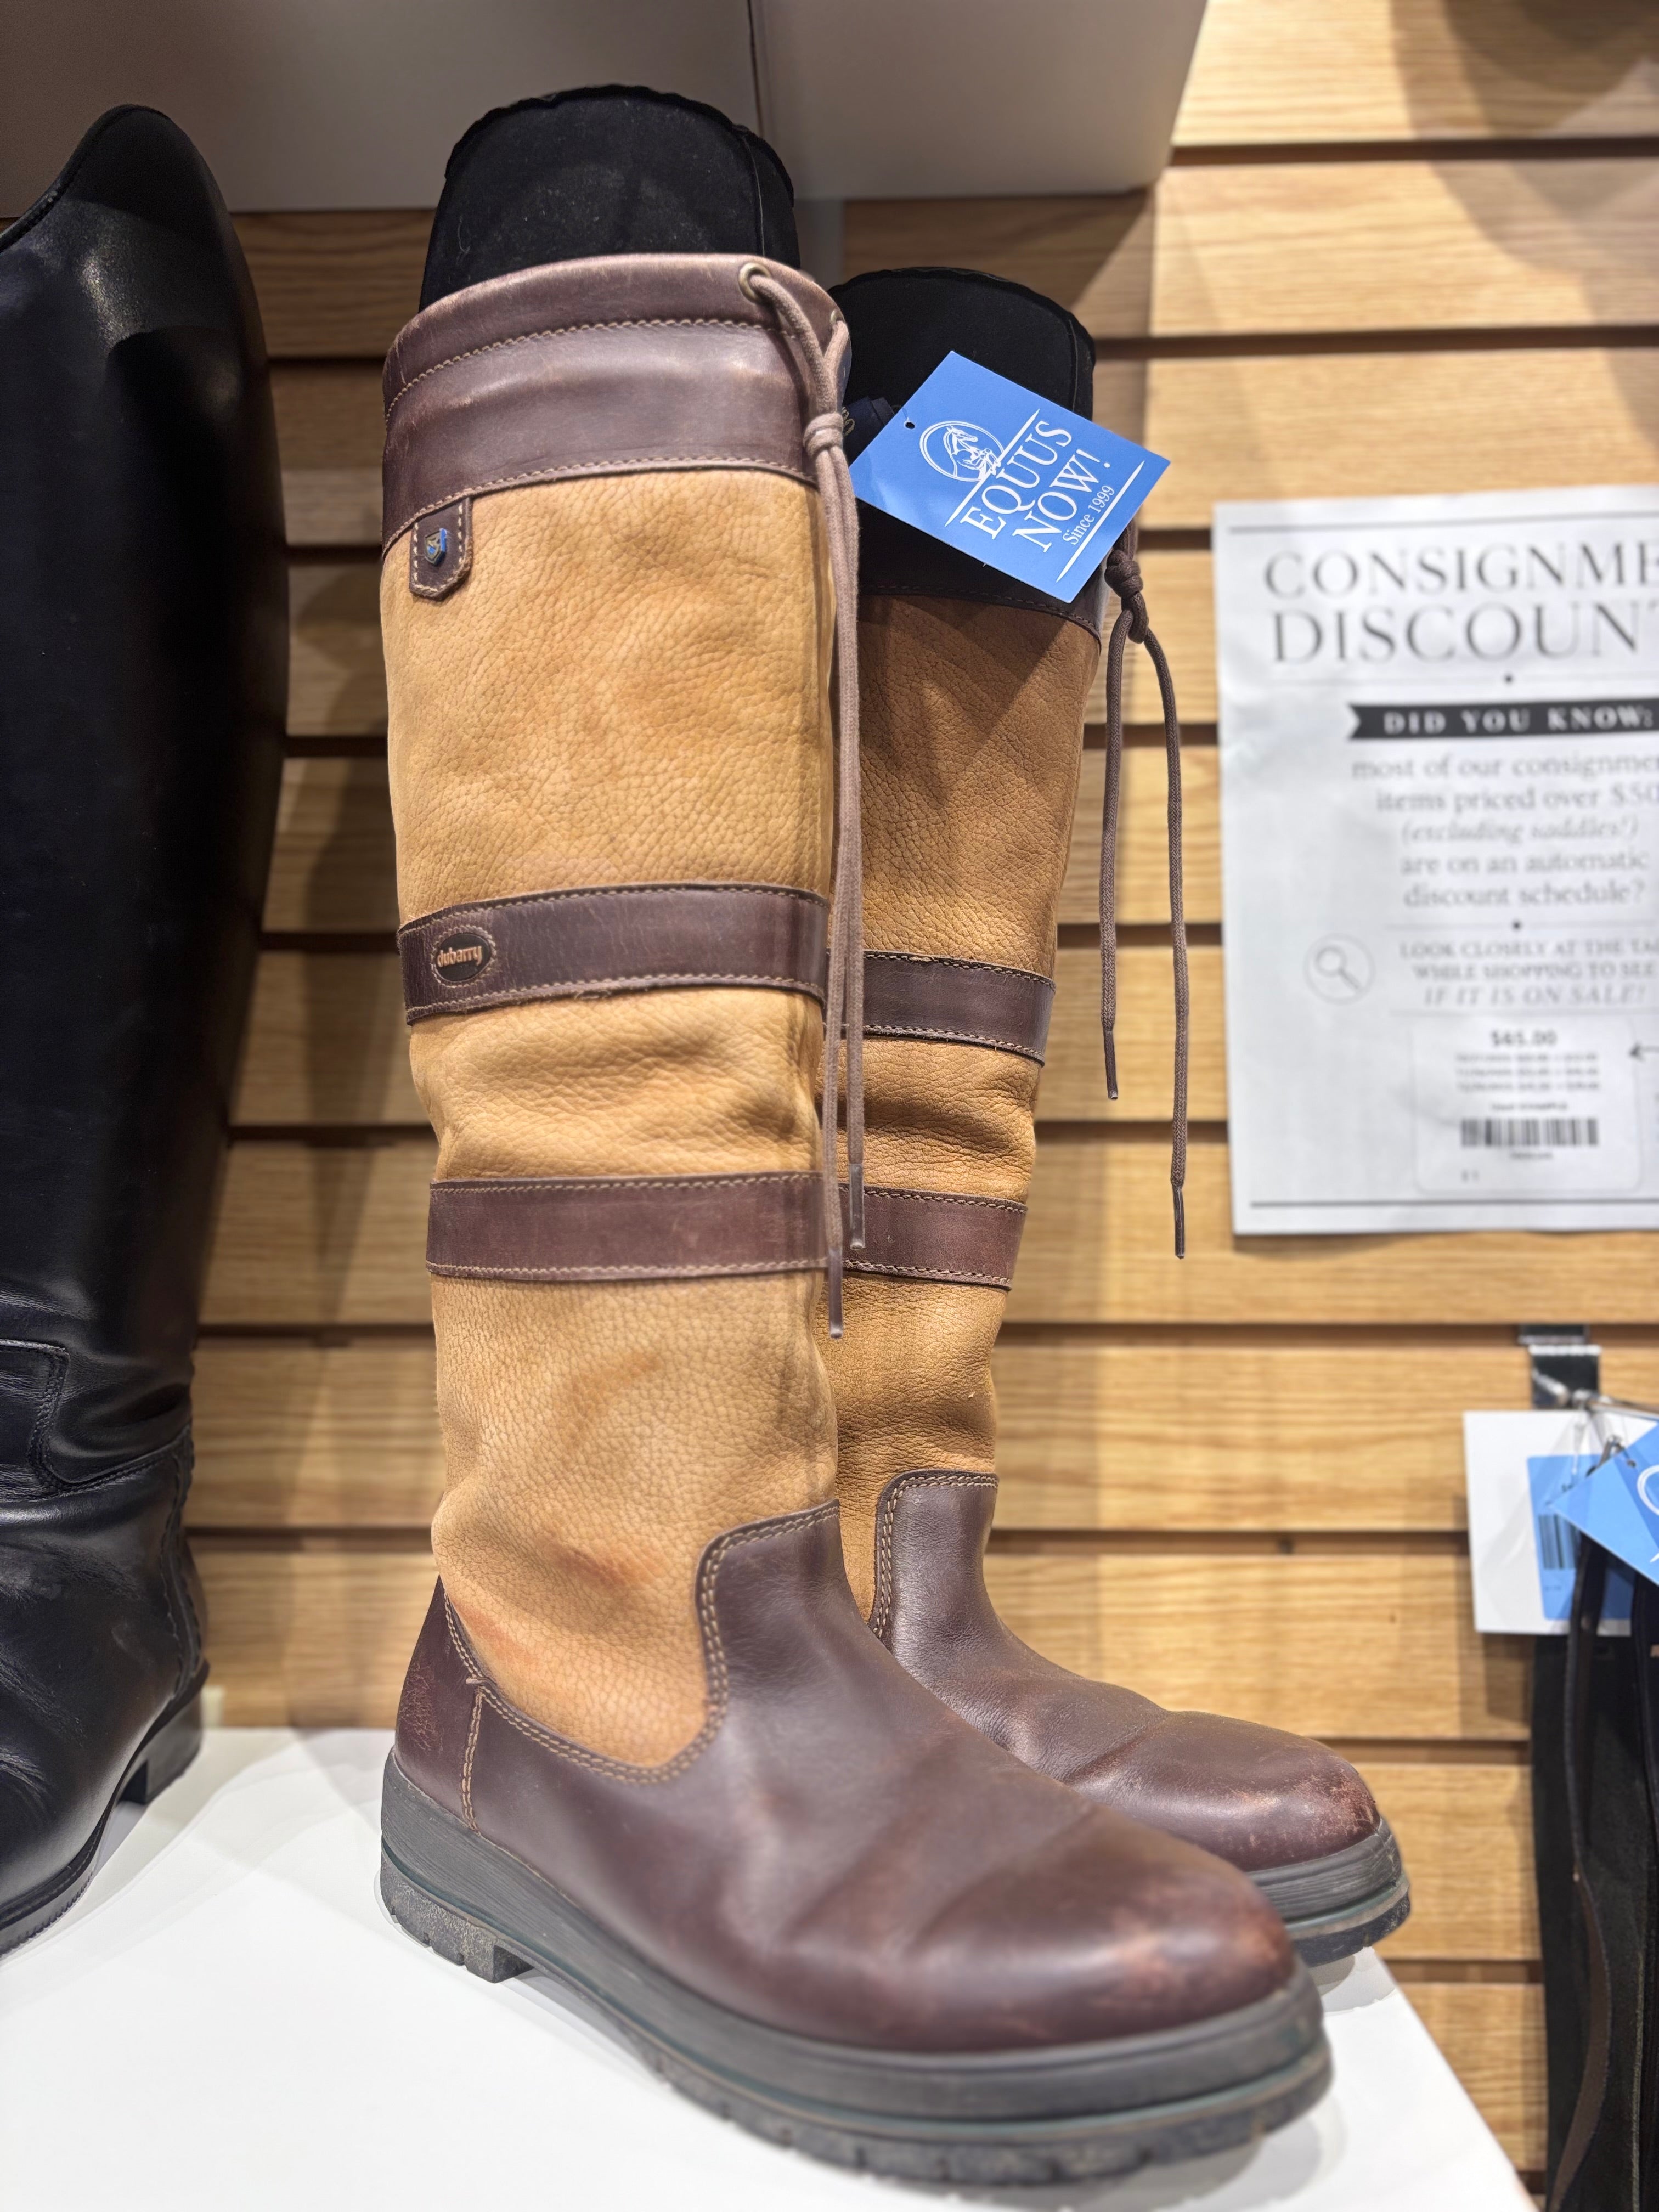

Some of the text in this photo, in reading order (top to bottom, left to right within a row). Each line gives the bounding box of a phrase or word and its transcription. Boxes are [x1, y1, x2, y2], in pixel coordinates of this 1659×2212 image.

[960, 419, 1073, 540] EQUUS
[1012, 448, 1110, 553] NOW!
[1062, 484, 1115, 546] Since 1999
[1383, 710, 1446, 735] DID
[1461, 709, 1530, 733] YOU
[1351, 749, 1659, 780] most of our consignme
[1376, 789, 1445, 812] items
[1454, 785, 1536, 814] priced
[1542, 789, 1600, 809] over
[1400, 845, 1650, 876] are on an automatic
[1403, 877, 1646, 909] discount schedule?
[437, 946, 483, 968] dubarry
[1400, 940, 1454, 959] LOOK
[1460, 939, 1547, 958] CLOSELY
[1555, 939, 1577, 956] AT
[1585, 938, 1622, 955] THE
[1412, 960, 1655, 981] WHILE SHOPPING TO SEE
[1424, 985, 1447, 1006] IF
[1456, 985, 1482, 1006] IT
[1490, 985, 1515, 1006] IS
[1522, 984, 1564, 1006] ON
